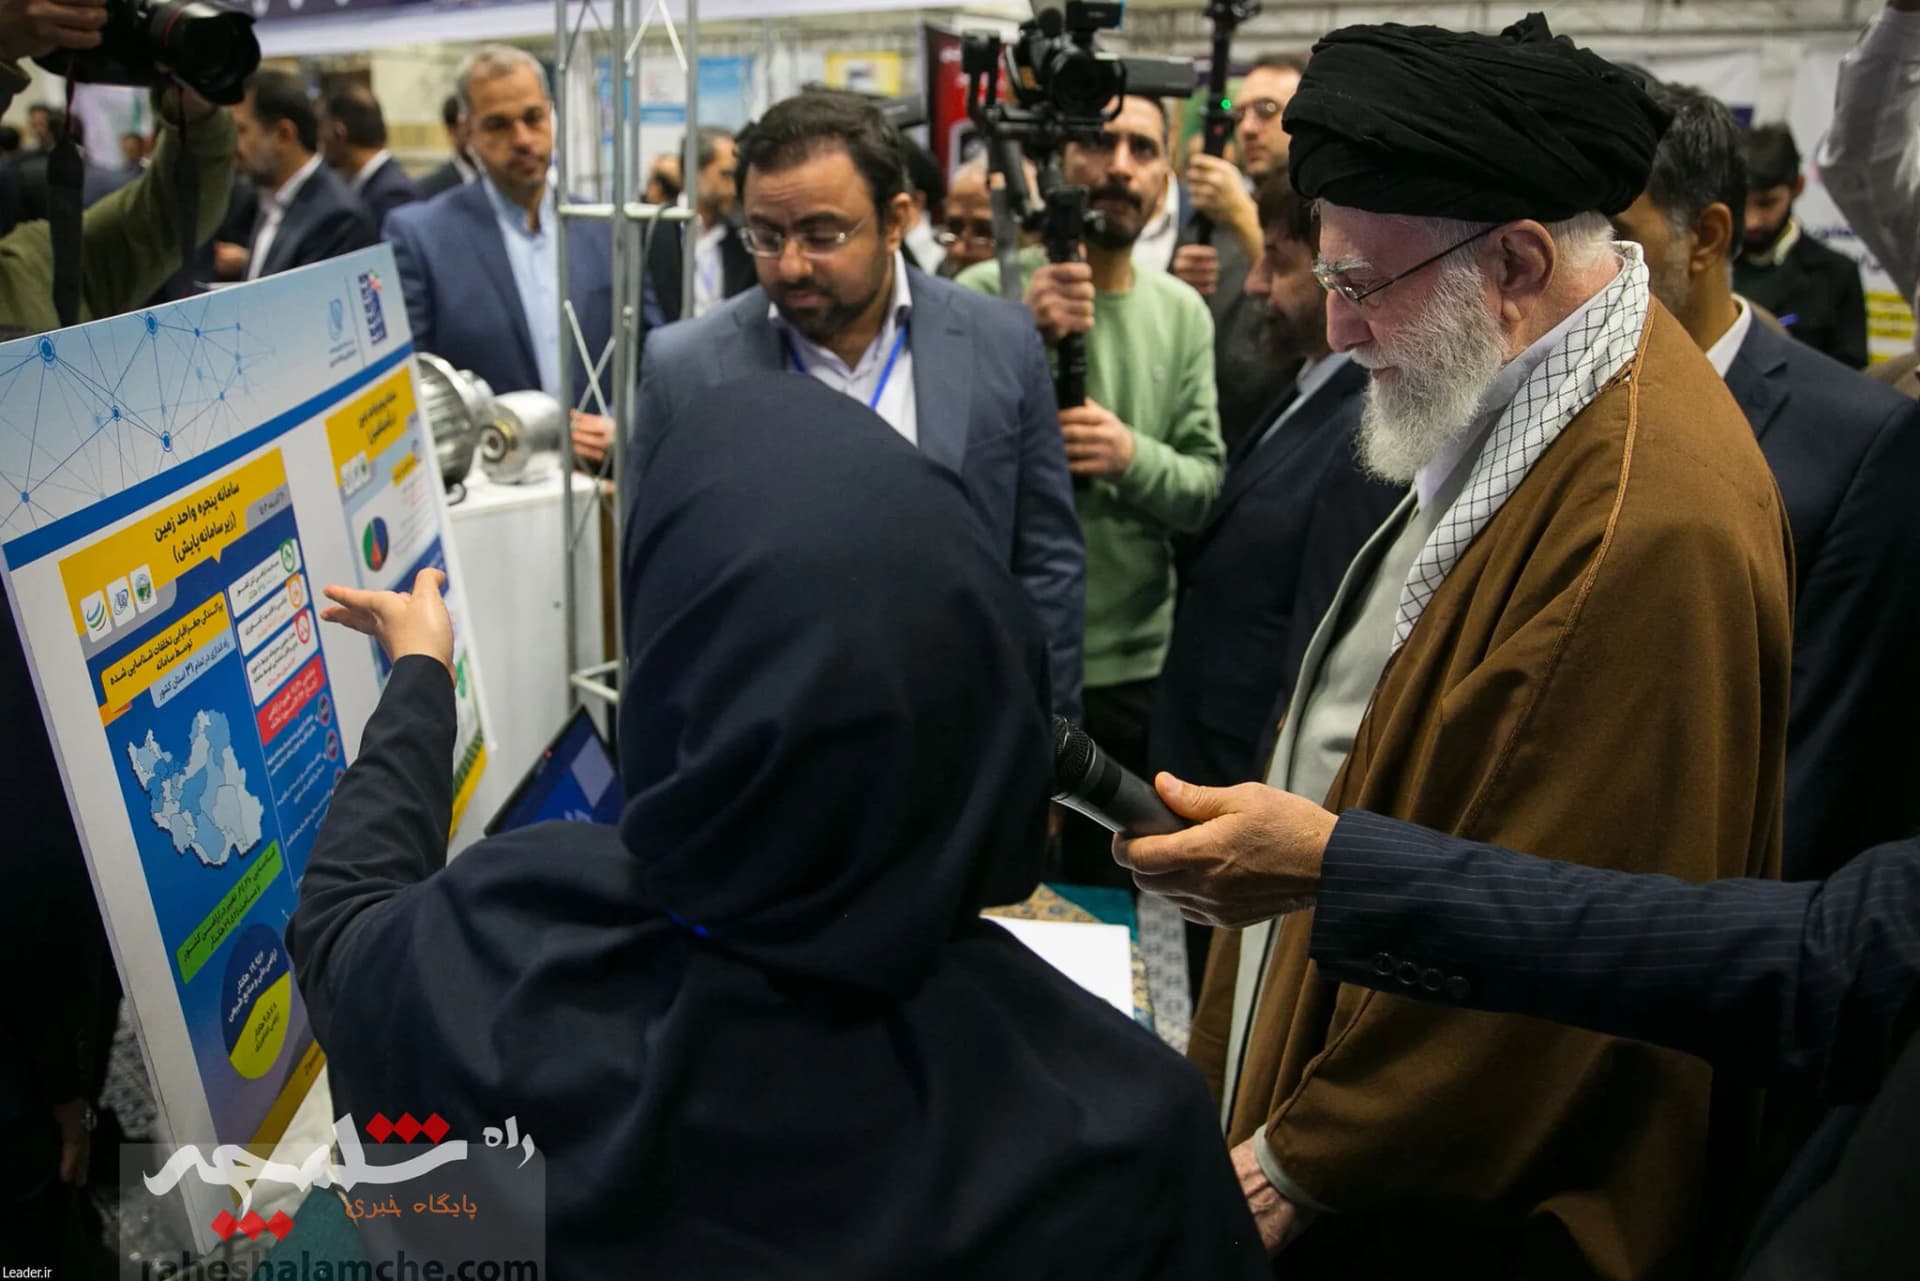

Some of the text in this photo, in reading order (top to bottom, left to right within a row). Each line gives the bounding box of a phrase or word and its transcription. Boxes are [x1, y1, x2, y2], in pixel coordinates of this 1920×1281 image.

[154, 481, 240, 542] سامانه پنجره واحد زمین
[127, 648, 154, 677] شناسایی
[156, 638, 193, 671] توسط سامانه
[110, 666, 127, 685] شده
